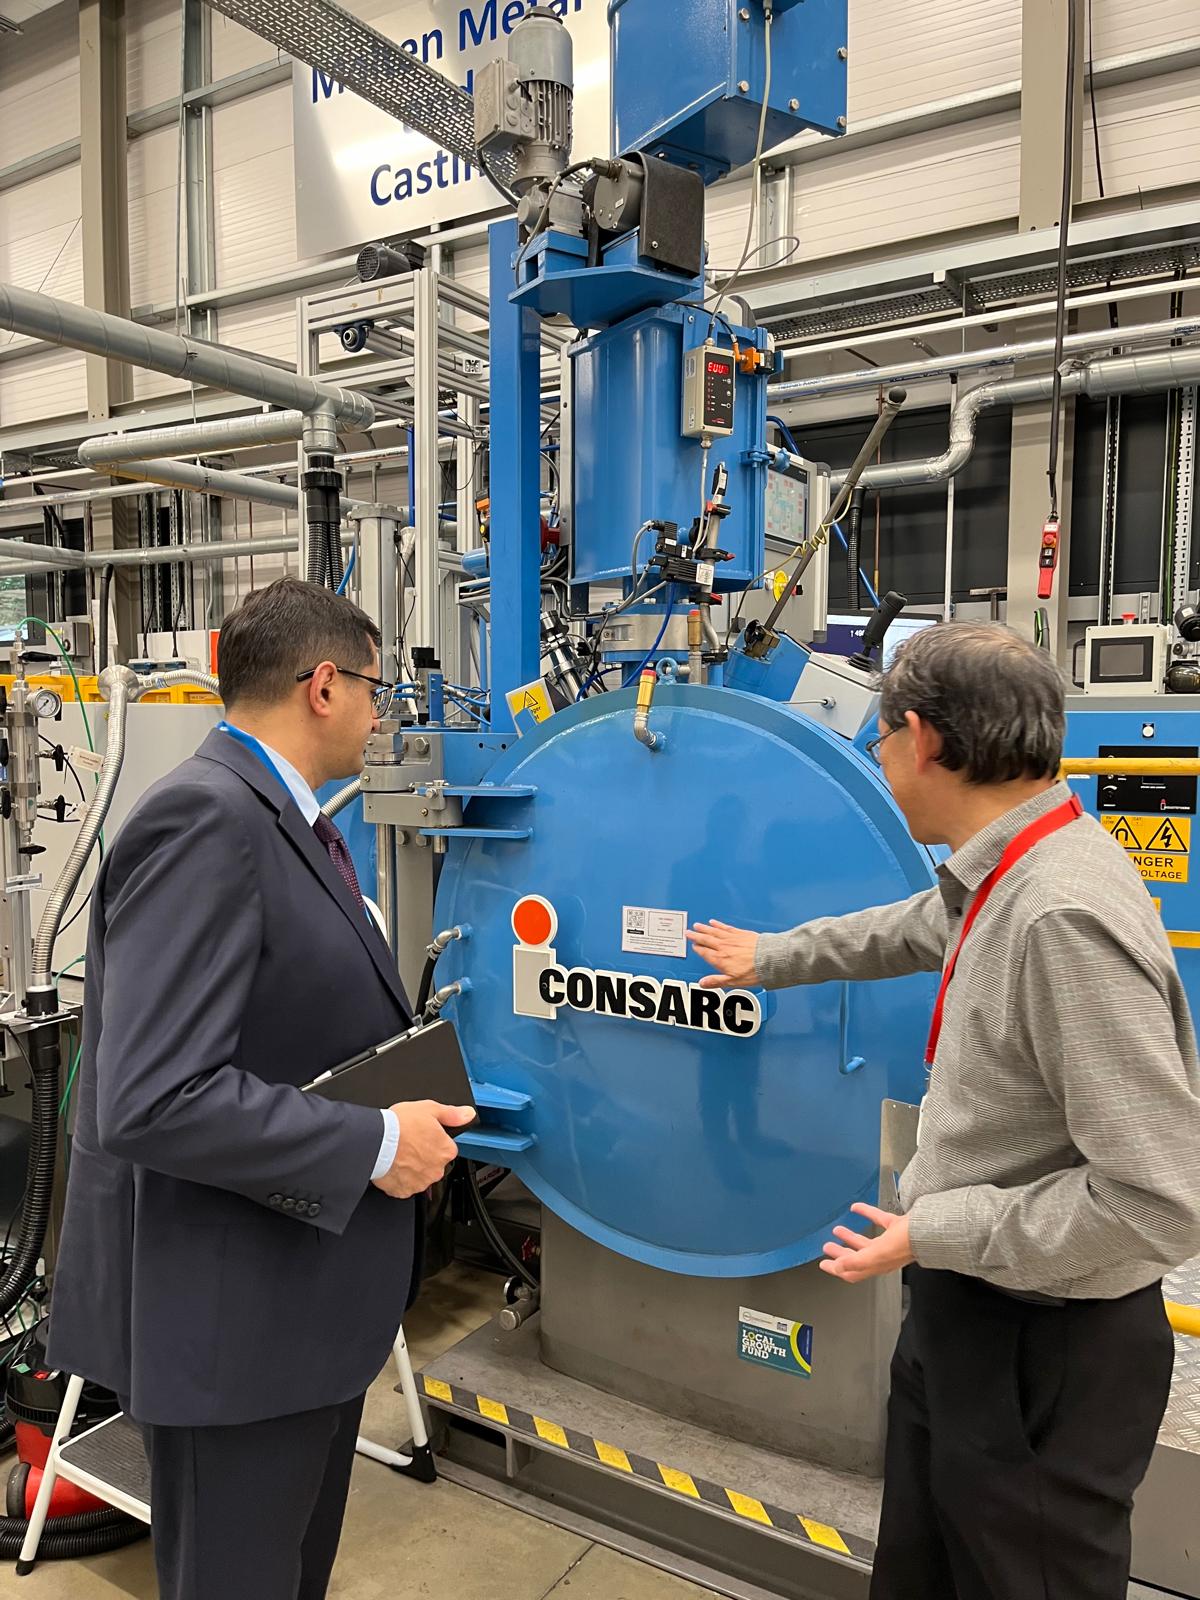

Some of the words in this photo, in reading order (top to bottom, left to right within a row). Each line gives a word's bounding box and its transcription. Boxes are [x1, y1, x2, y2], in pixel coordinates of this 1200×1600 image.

[370, 149, 485, 206] Casti
[1133, 856, 1173, 867] NGER
[1139, 870, 1182, 879] OLTAGE
[539, 968, 754, 1034] CONSARC
[743, 1330, 774, 1345] LOCAL
[742, 1338, 786, 1357] GROWTH
[742, 1345, 769, 1359] FUND
